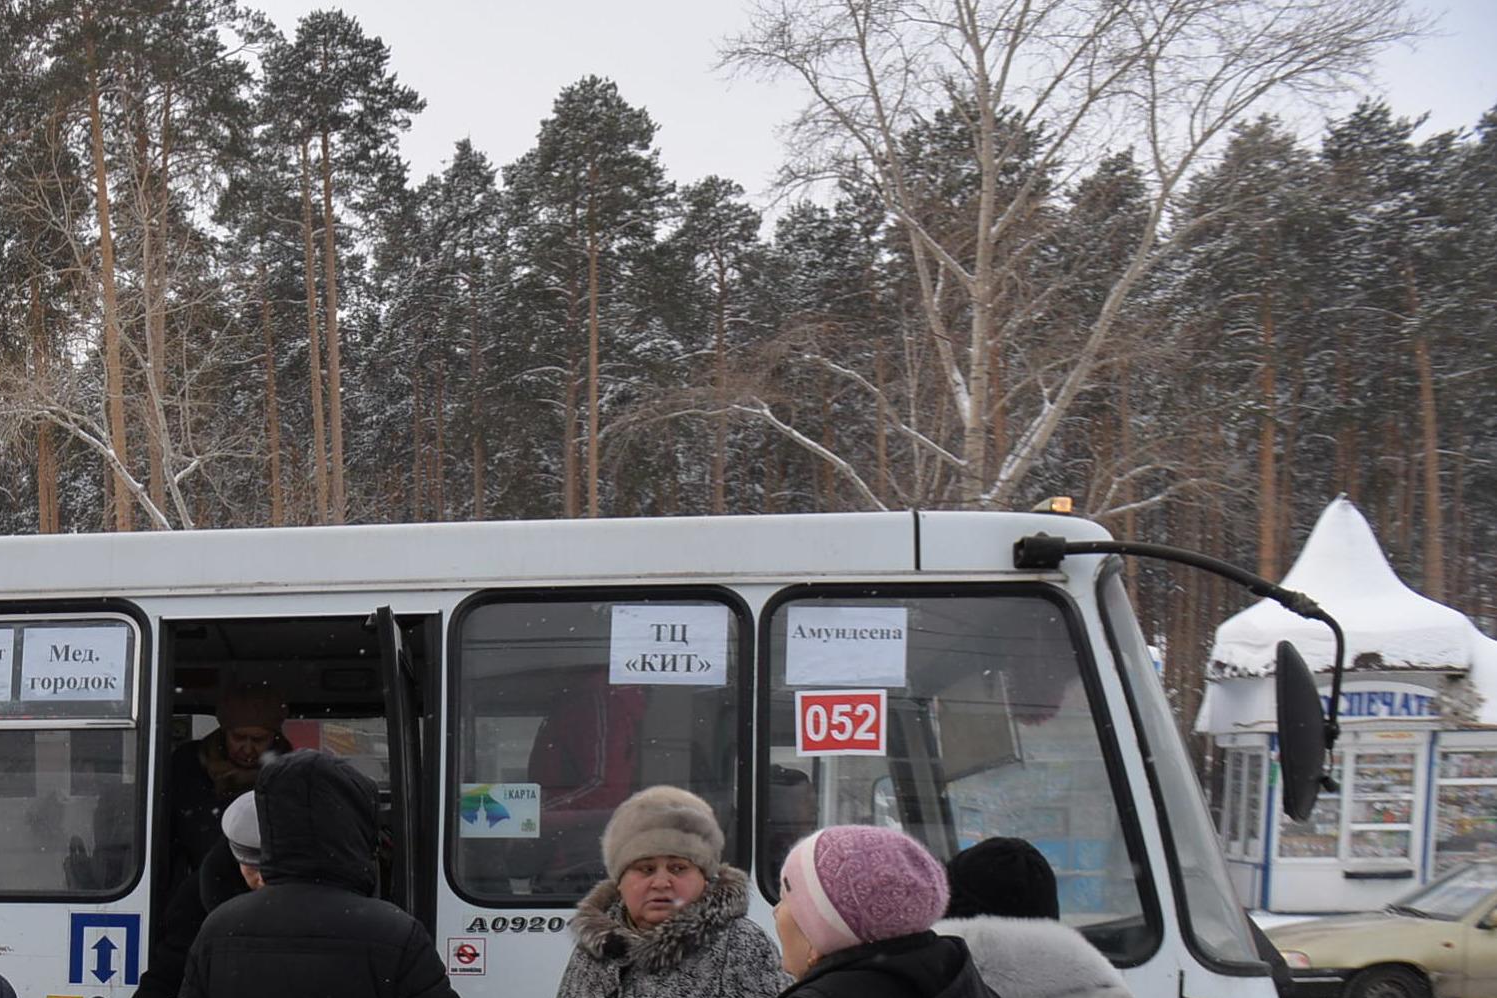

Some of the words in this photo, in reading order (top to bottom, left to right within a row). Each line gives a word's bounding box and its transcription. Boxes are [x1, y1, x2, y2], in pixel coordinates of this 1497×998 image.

[650, 623, 689, 645] ТЦ
[791, 623, 903, 643] Амундсена
[49, 644, 100, 664] Мед.
[625, 653, 712, 673] «КИТ»
[29, 674, 118, 694] городок
[805, 703, 877, 742] 052
